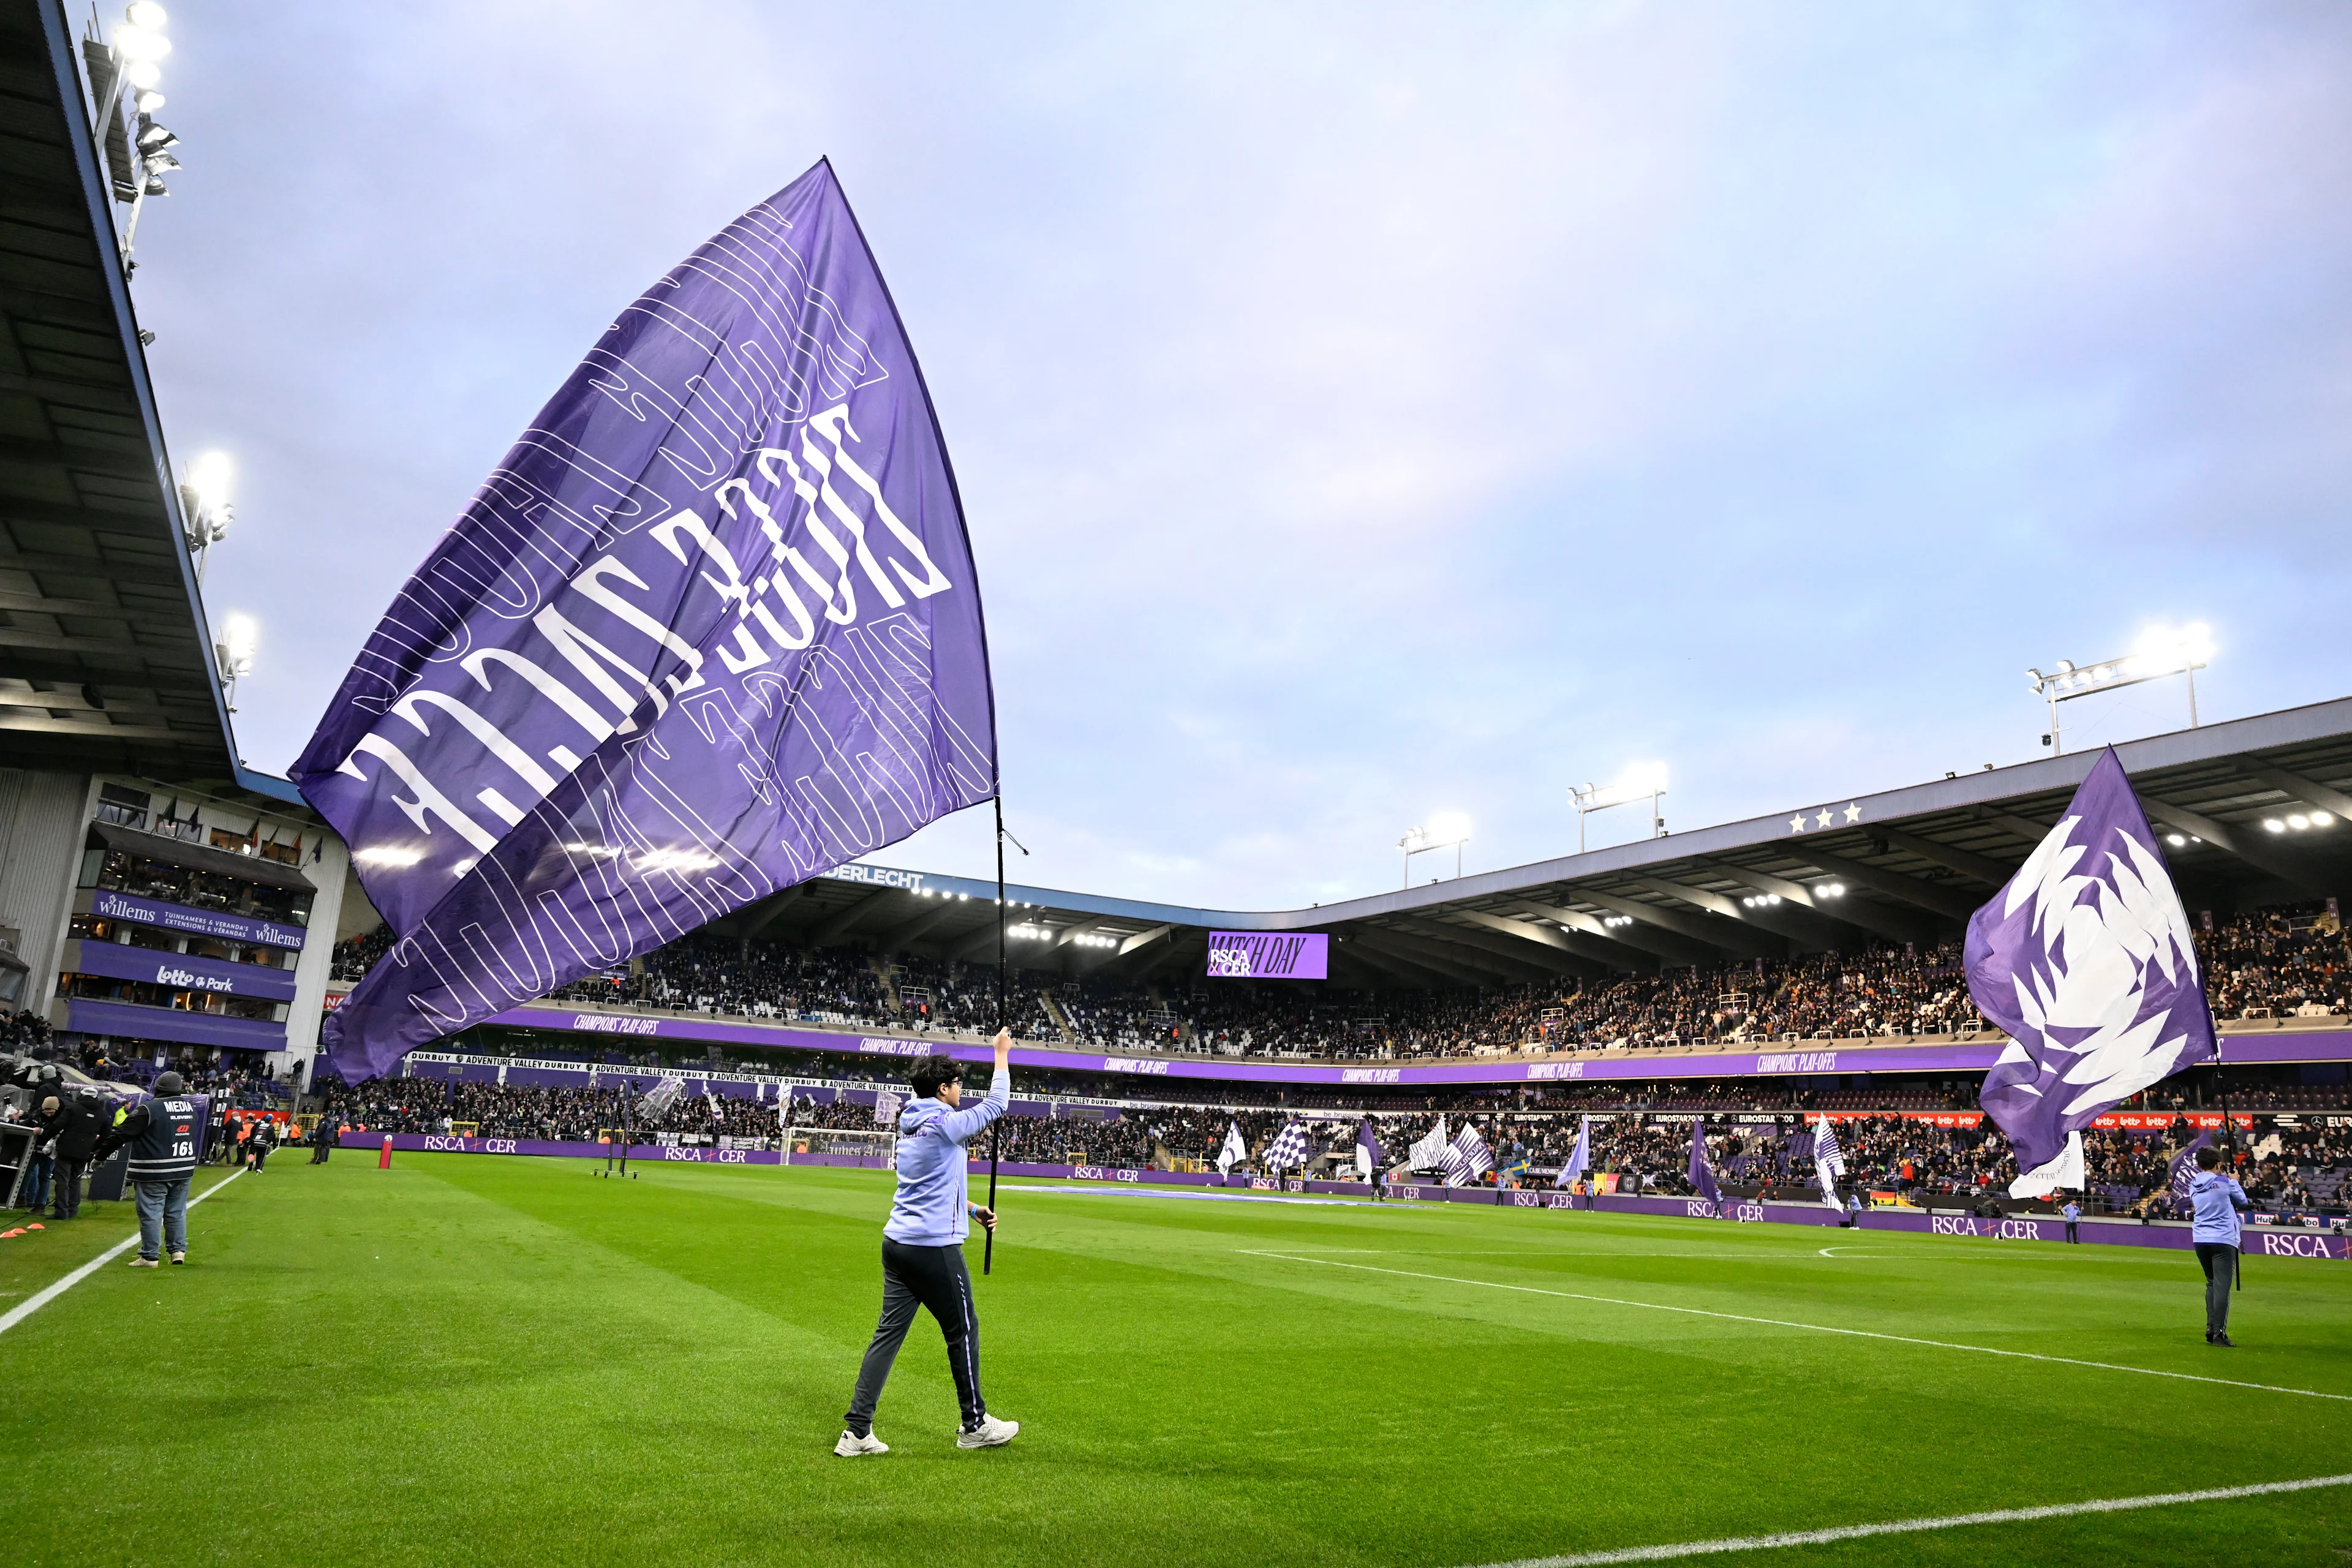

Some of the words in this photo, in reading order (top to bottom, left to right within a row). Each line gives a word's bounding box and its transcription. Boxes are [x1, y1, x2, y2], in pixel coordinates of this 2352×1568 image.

[819, 865, 923, 888] DERLECHT
[100, 897, 156, 922] willems
[165, 911, 206, 925] TUINKAMERS
[215, 920, 249, 932] VERANDA'S
[165, 919, 205, 931] EXTENSIONS
[214, 926, 246, 938] VÉRANDAS
[256, 925, 301, 947] willems
[1210, 949, 1250, 963] RSCA
[1264, 937, 1306, 974] DAY
[1221, 962, 1251, 976] CER
[206, 978, 233, 992] Park
[574, 1014, 620, 1031] CHAMPIONS'
[619, 1019, 659, 1035] PLAY-OFFS
[859, 1038, 900, 1054] CHAMPIONS'
[898, 1041, 933, 1056] PLAY-OFFS
[412, 1053, 451, 1061] DURBUY
[466, 1055, 513, 1066] ADVENTURE
[514, 1059, 542, 1068] VALLEY
[1757, 1054, 1800, 1072] CHAMPIONS'
[1798, 1052, 1837, 1071] PLAY-OFFS
[595, 1065, 638, 1074] ADVENTURE
[641, 1068, 667, 1076] VALLEY
[1137, 1060, 1169, 1074] PLAY-OFFS
[1556, 1062, 1585, 1078] PLAY-OFFS
[716, 1074, 756, 1083] ADVENTURE
[758, 1076, 783, 1084] VALLEY
[1373, 1069, 1401, 1082] PLAY-OFFS
[829, 1080, 867, 1090] ADVENTURE
[869, 1083, 891, 1091] VALLEY
[164, 1101, 194, 1112] MEDIA
[1035, 1095, 1068, 1103] ADVENTURE
[2236, 1117, 2250, 1126] tto
[424, 1136, 465, 1151] RSCA
[486, 1139, 516, 1153] CER
[665, 1147, 701, 1161] RSCA
[719, 1149, 746, 1163] CER
[1075, 1166, 1103, 1180] RSCA
[1117, 1169, 1138, 1182] CER
[1253, 1177, 1280, 1190] RSCA
[1289, 1180, 1303, 1192] CER
[1403, 1186, 1419, 1199] CER
[1514, 1193, 1539, 1207] RSCA
[1552, 1194, 1573, 1209] CER
[1737, 1204, 1763, 1221] CER
[1932, 1216, 1978, 1236] RSCA
[2001, 1220, 2040, 1240] CER
[2264, 1234, 2331, 1258] RSCA
